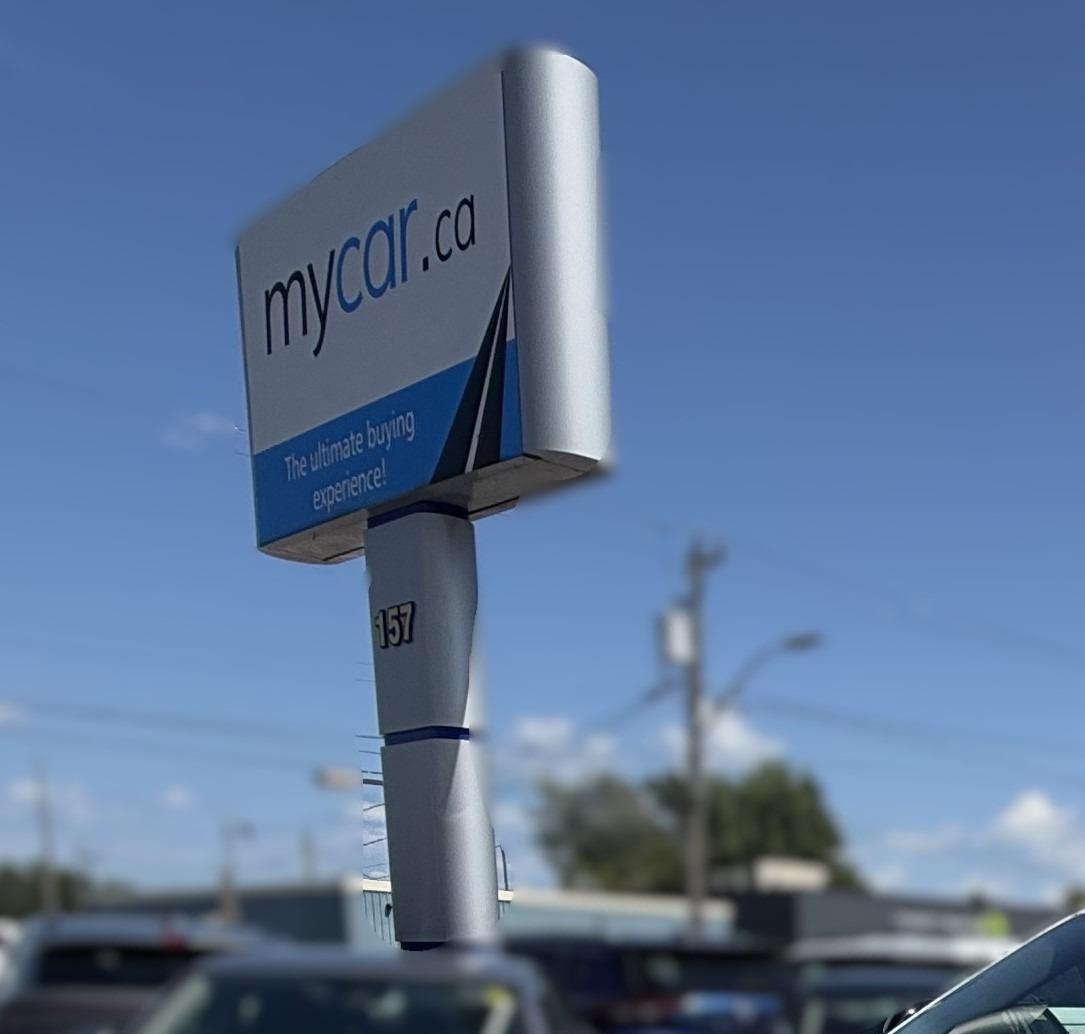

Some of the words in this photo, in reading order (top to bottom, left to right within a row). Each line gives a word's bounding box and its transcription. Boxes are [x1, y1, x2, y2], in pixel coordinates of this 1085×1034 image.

[264, 194, 476, 357] mycar.ca
[284, 452, 307, 482] The
[309, 430, 364, 472] ultimate
[366, 410, 415, 451] buying
[312, 457, 388, 514] experience!
[374, 600, 416, 650] 157
